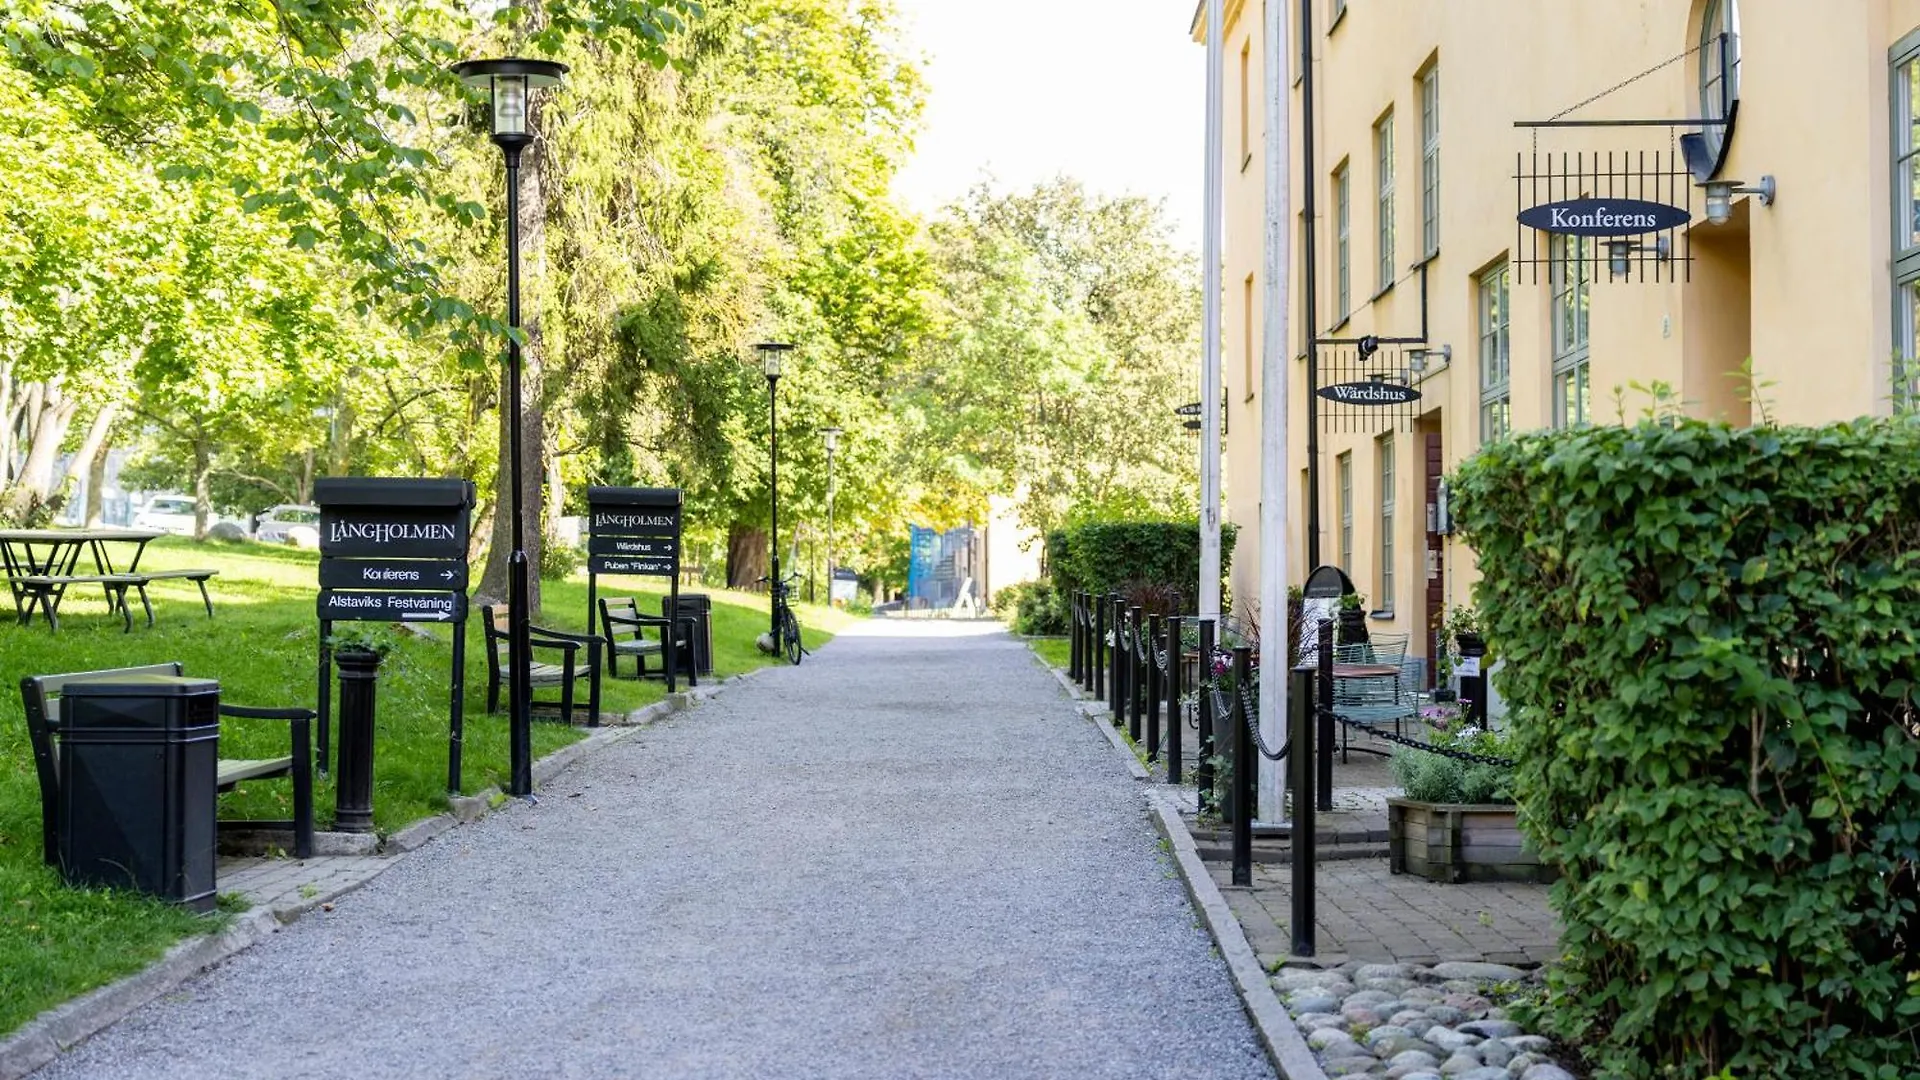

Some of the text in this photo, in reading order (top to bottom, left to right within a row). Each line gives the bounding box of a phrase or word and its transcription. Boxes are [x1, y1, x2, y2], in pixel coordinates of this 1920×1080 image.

[1550, 207, 1656, 228] Konferens
[1334, 386, 1406, 400] Wärdshus
[595, 512, 674, 528] LÅNGHOLMEN
[330, 520, 455, 542] LÅNGHOLMEN
[604, 561, 629, 570] Puben
[328, 595, 382, 608] Alstaviks
